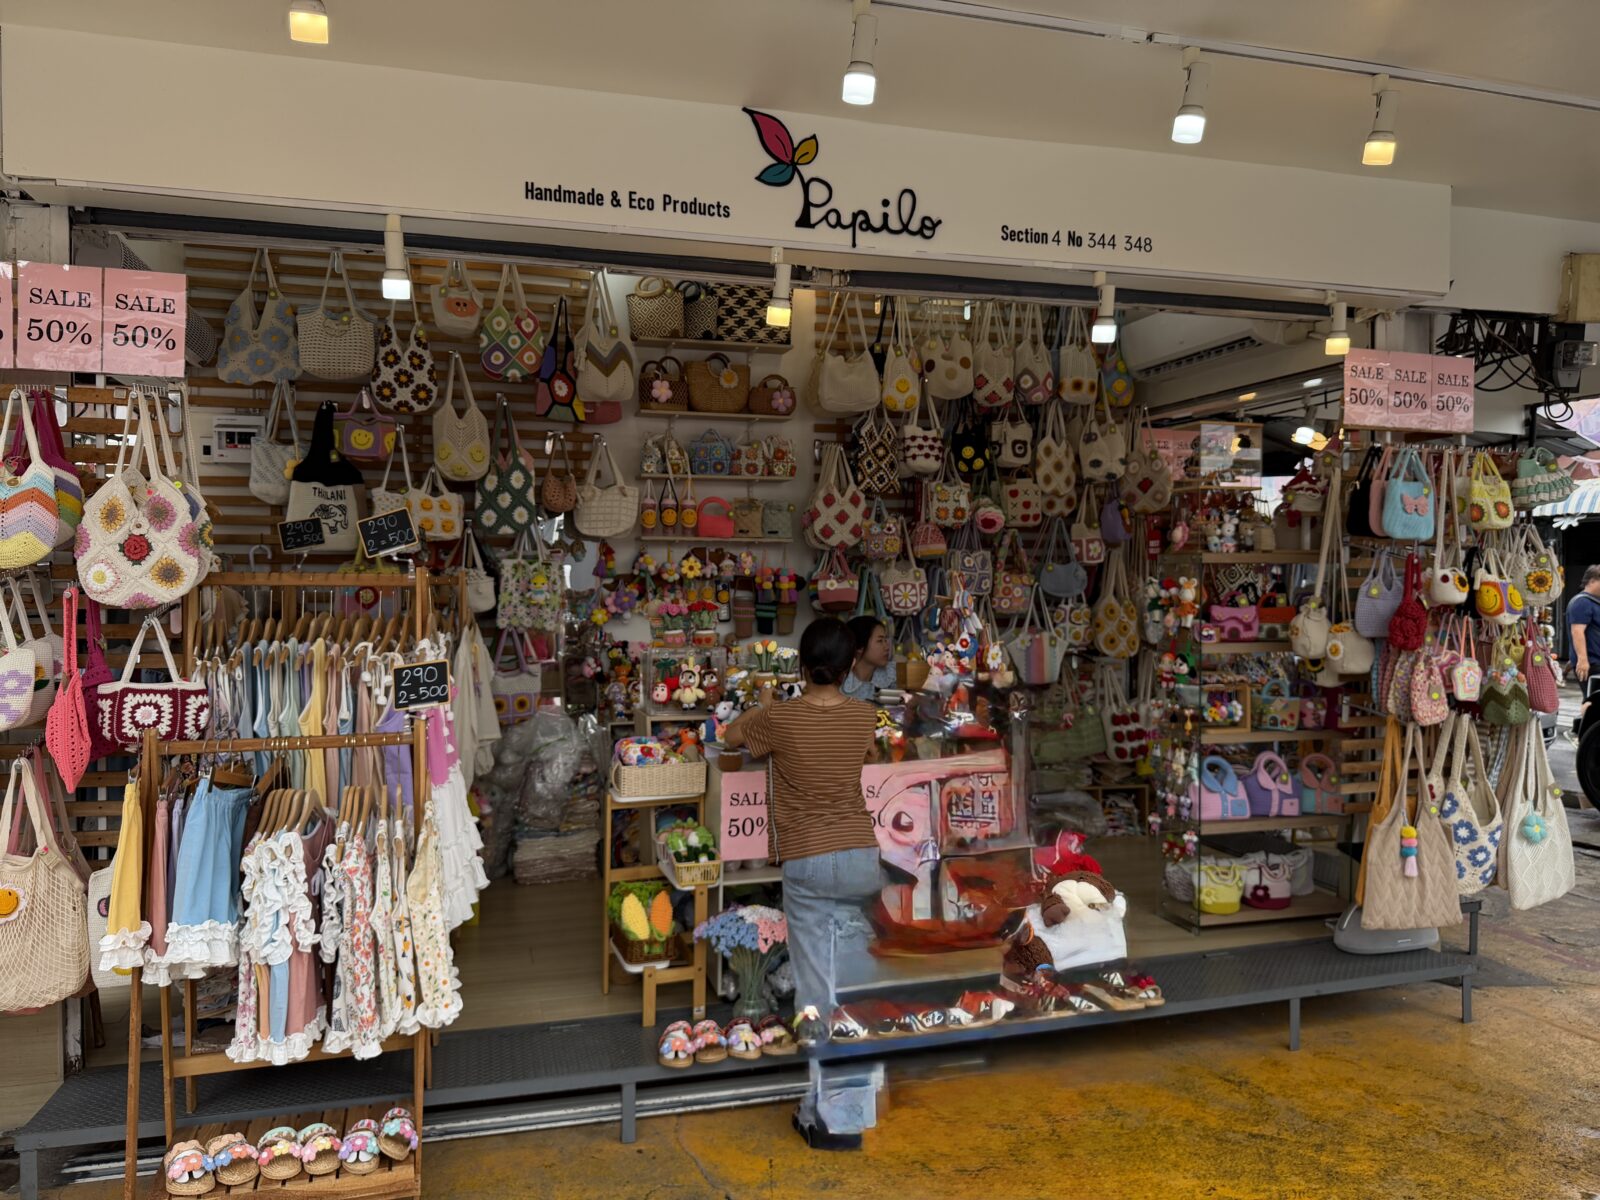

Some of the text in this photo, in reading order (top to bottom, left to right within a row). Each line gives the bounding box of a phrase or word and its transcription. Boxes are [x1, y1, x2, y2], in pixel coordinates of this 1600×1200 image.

[525, 181, 730, 218] Handmade & Eco Products
[795, 177, 942, 248] Papilo
[1001, 225, 1153, 253] Section 4 No 344 348
[29, 288, 91, 308] SALE
[115, 293, 176, 314] SALE
[27, 318, 92, 345] 50%
[112, 323, 176, 350] 50%
[1350, 365, 1384, 380] SALE
[1394, 369, 1427, 384] SALE
[1437, 373, 1469, 387] SALE
[1350, 388, 1383, 406] 50%
[1393, 391, 1427, 410] 50%
[1436, 395, 1470, 413] 50%
[286, 521, 314, 535] 290
[368, 515, 398, 534] 290
[401, 666, 438, 686] 290
[728, 816, 769, 838] 50%
